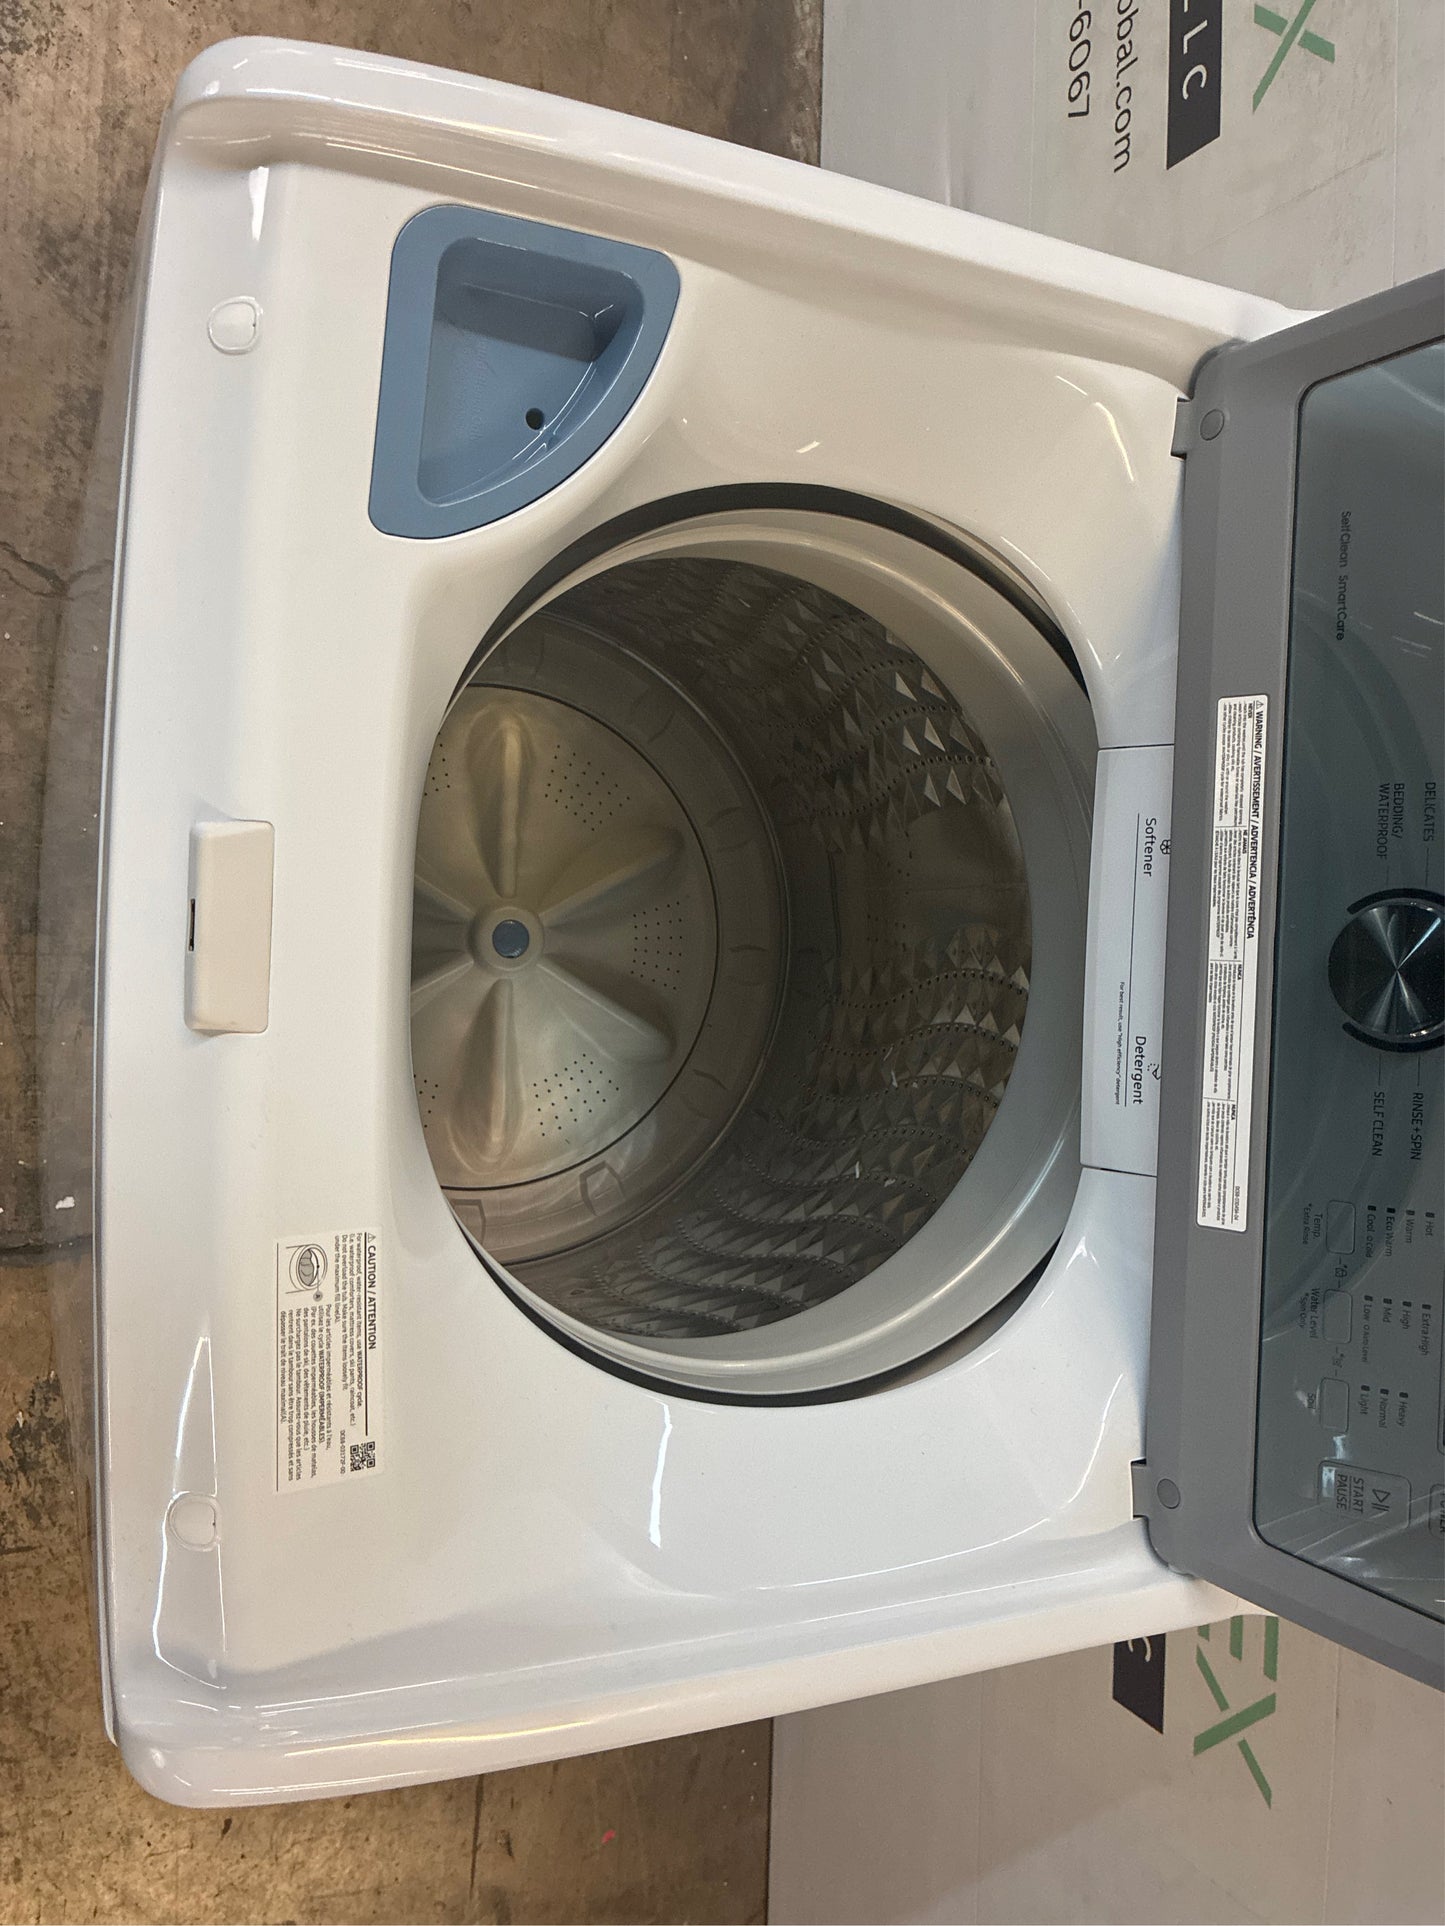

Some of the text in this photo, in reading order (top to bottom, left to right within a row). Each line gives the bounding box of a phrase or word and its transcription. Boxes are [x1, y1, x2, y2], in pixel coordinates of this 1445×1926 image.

[1336, 575, 1349, 641] SmartCare
[1254, 711, 1265, 748] WARNING
[1250, 755, 1263, 818] AVERTISSEMENT
[1376, 783, 1390, 860] WATERPROOF
[1391, 783, 1405, 839] BEDDING/
[1423, 782, 1436, 842] DELICATES
[1142, 817, 1158, 877] Softener
[1247, 825, 1261, 879] ADVERTENCIA
[1246, 886, 1260, 939] ADVERTÊNCIA
[1130, 1035, 1148, 1105] Detergent
[1371, 1091, 1385, 1157] SELF CLEAN
[1311, 1213, 1323, 1240] Temp.
[1366, 1213, 1377, 1232] Cool
[1384, 1216, 1395, 1257] Eco Warm
[1405, 1219, 1414, 1244] Warm
[1425, 1220, 1434, 1238] Hot
[367, 1246, 376, 1288] CAUTION
[367, 1296, 377, 1350] ATTENTION
[1308, 1288, 1321, 1339] Water Level
[1363, 1304, 1372, 1321] Low
[1383, 1307, 1392, 1323] Mid
[1400, 1310, 1411, 1330] High
[1418, 1313, 1431, 1356] Extra High
[1379, 1398, 1388, 1428] Normal
[1397, 1401, 1407, 1427] Heavy
[1336, 1473, 1349, 1510] PAUSE
[1352, 1477, 1364, 1513] START
